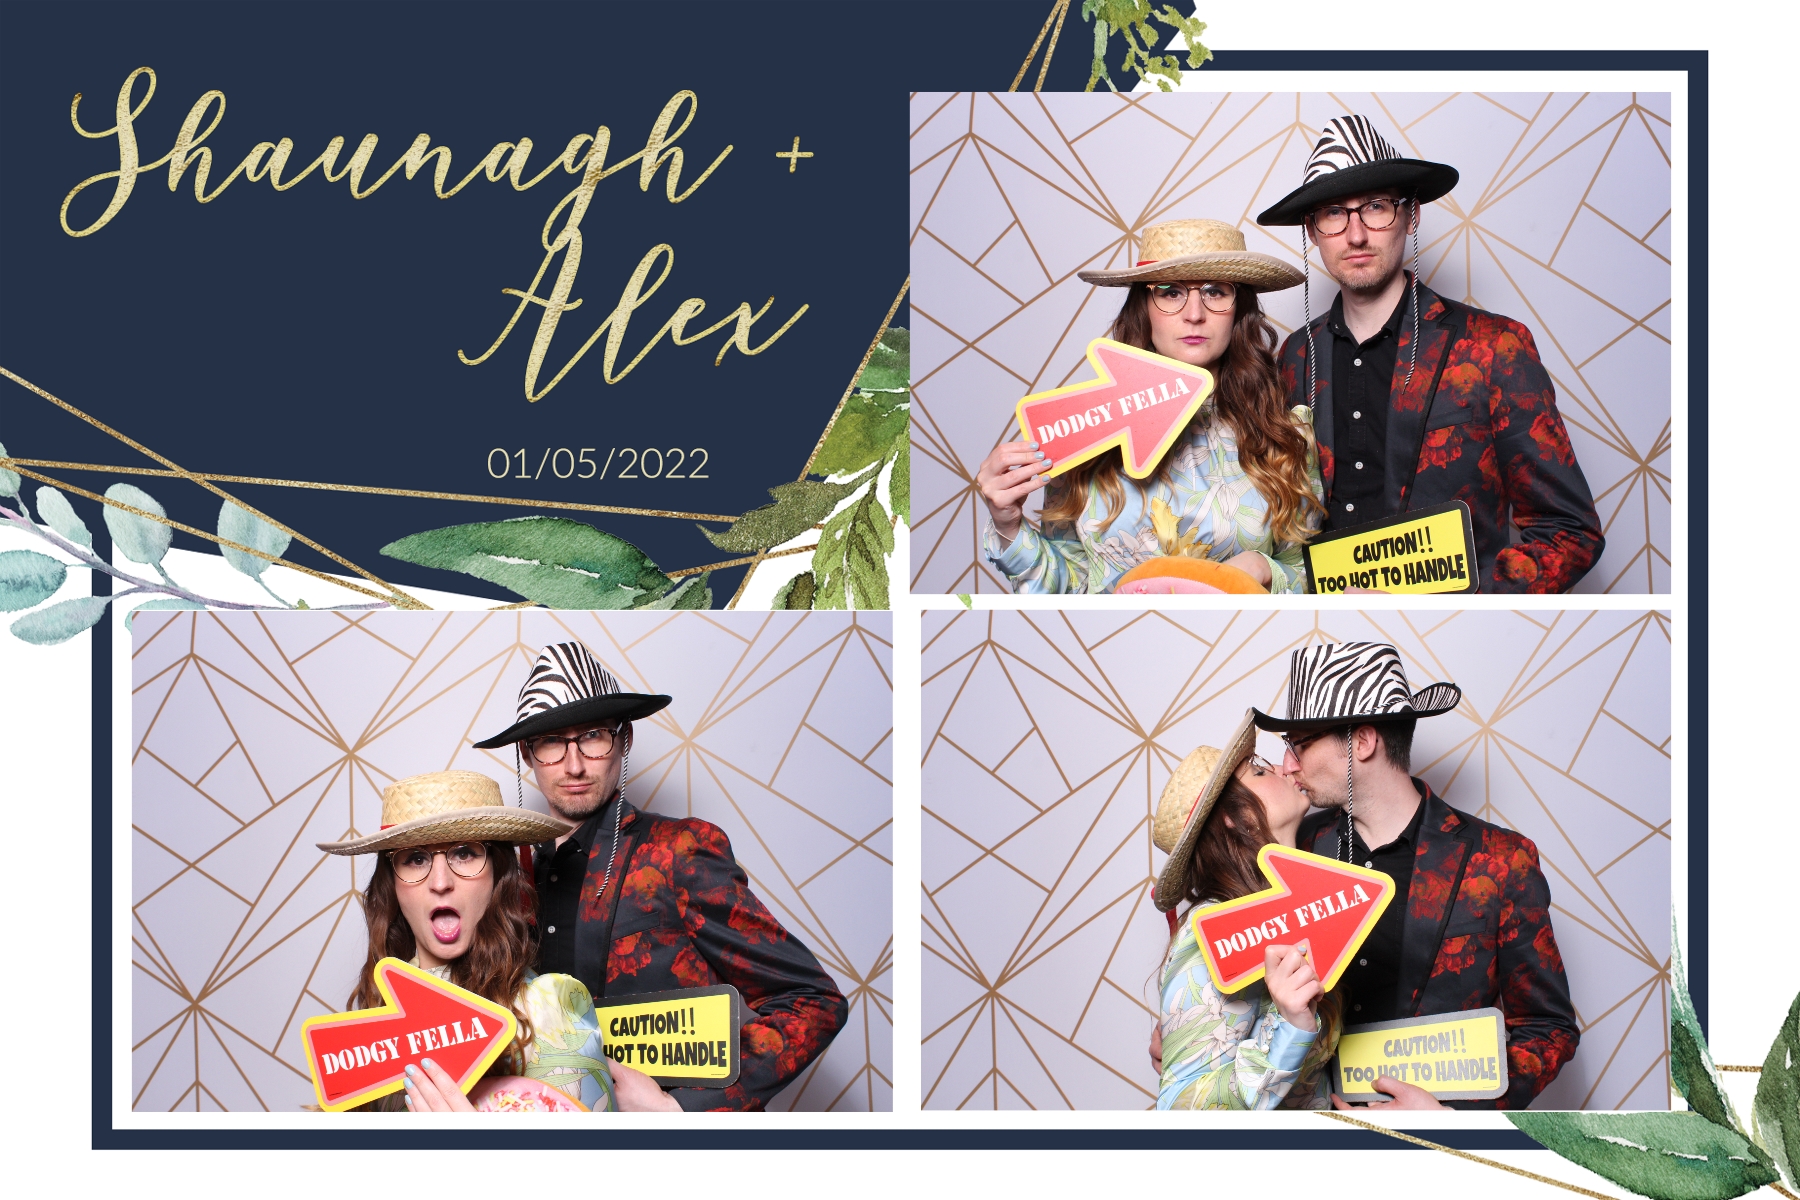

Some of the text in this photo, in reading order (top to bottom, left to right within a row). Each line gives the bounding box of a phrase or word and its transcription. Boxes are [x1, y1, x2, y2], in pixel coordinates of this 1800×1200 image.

[1037, 377, 1190, 444] DODGY FELLA
[1353, 526, 1433, 564] CAUTION!!
[1318, 554, 1466, 593] TOO HOT TO HANDLE
[1214, 883, 1370, 959] DODGY FELLA
[610, 1007, 696, 1037] CAUTION!!
[322, 1016, 488, 1075] DODGY FELLA
[603, 1041, 727, 1067] HOT TO HANDLE
[1383, 1028, 1466, 1058] CAUTION!!
[1344, 1066, 1374, 1082] TOO
[1411, 1062, 1432, 1081] TO
[1435, 1057, 1497, 1082] HANDLE
